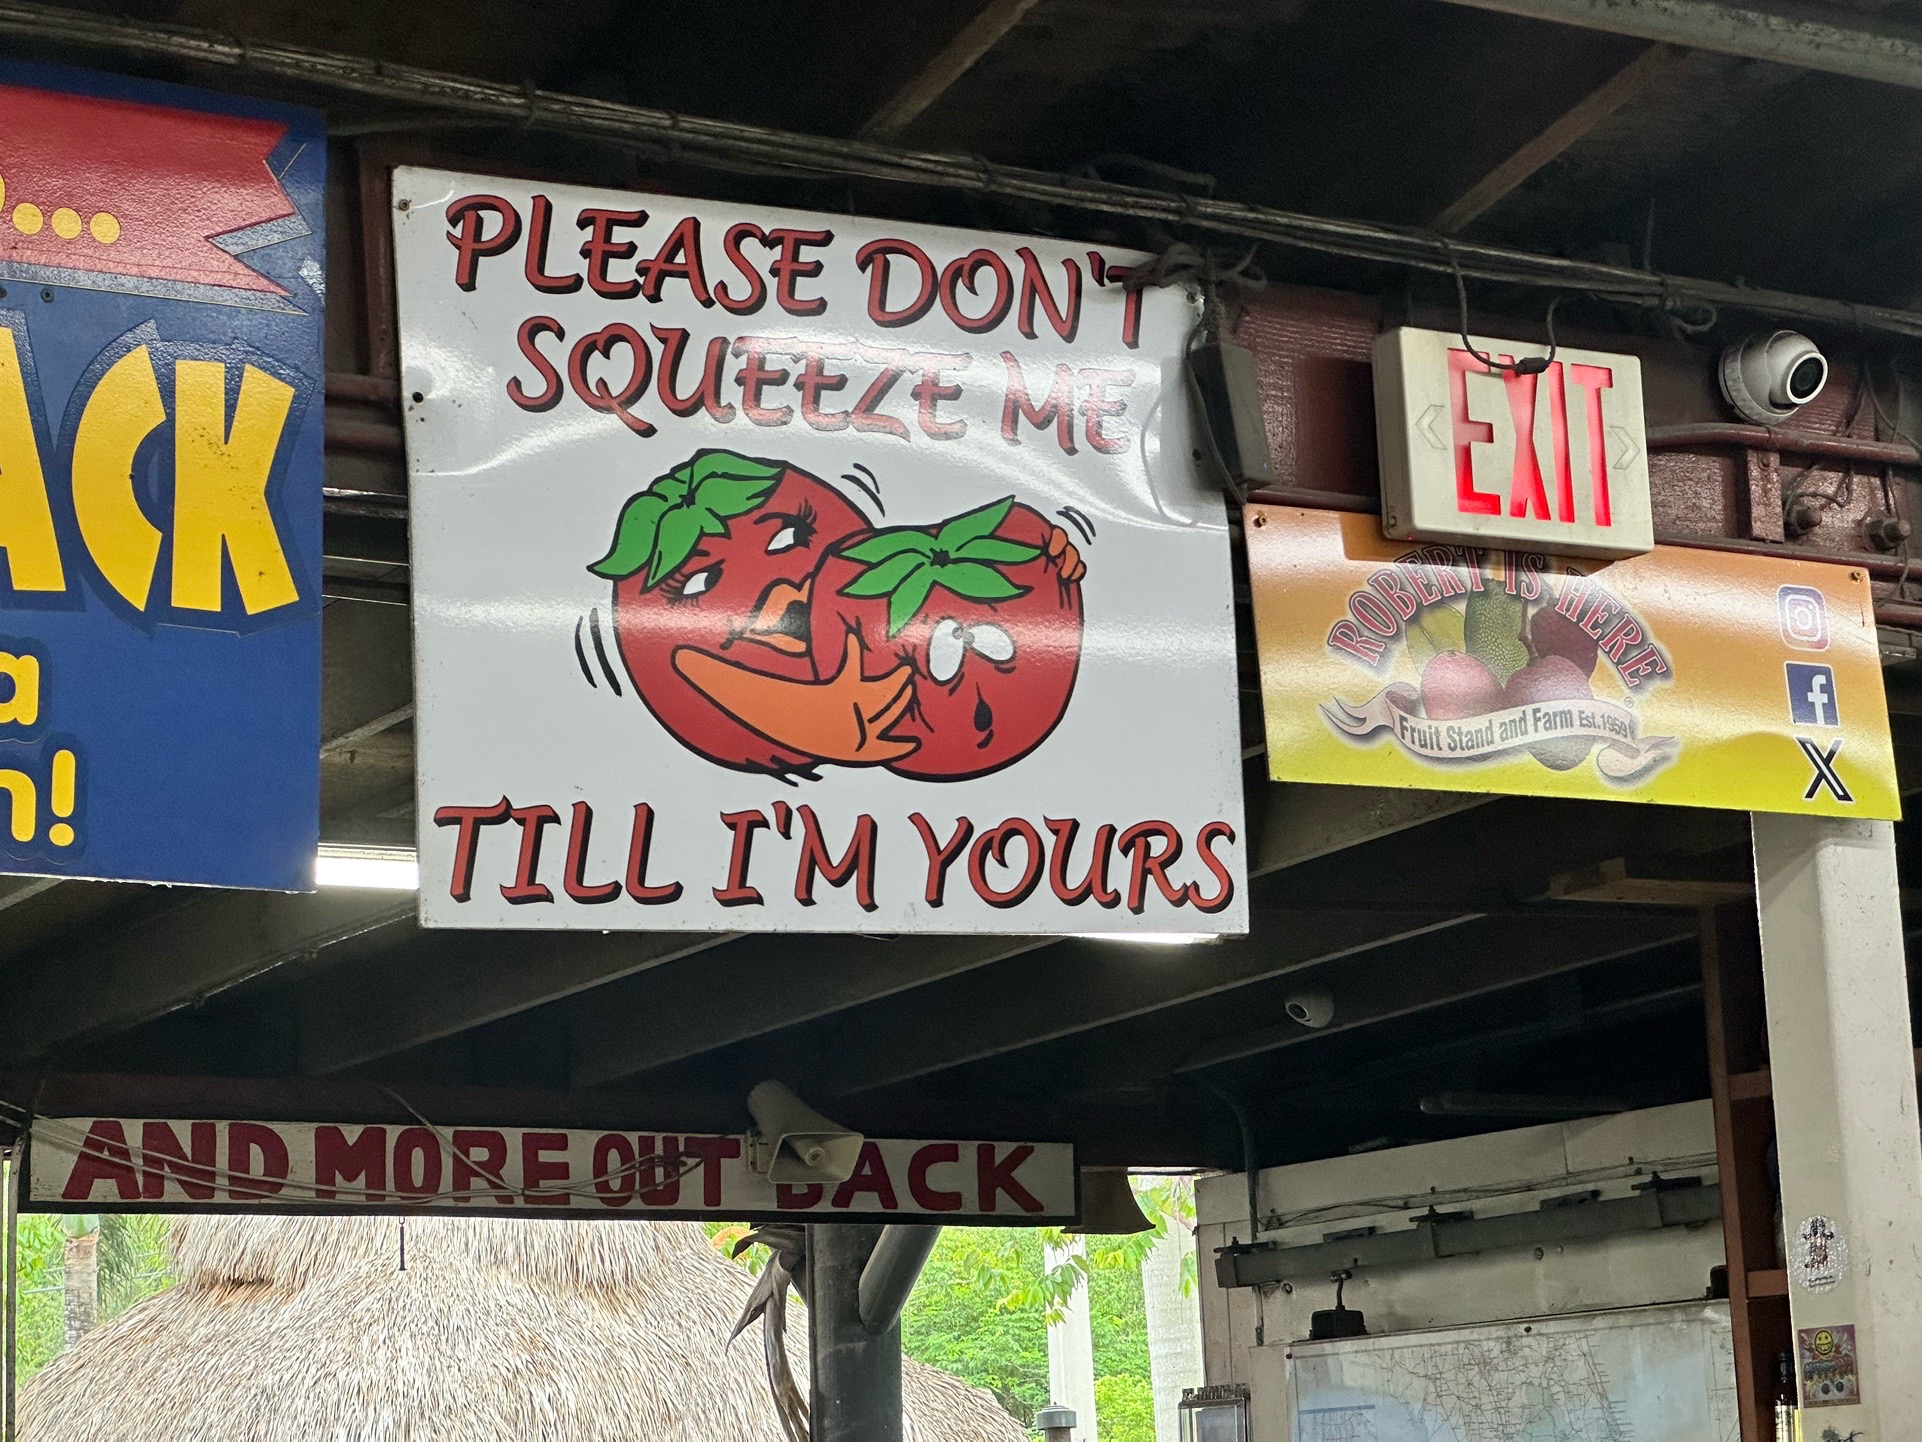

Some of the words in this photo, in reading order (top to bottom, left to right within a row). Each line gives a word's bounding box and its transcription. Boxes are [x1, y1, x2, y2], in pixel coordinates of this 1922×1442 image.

[446, 194, 835, 318] PLEASE
[855, 238, 1152, 349] DON'T
[506, 315, 973, 441] SQUEEZE
[1000, 350, 1139, 456] ME
[1447, 347, 1613, 527] EXIT
[1328, 545, 1484, 667] ROBERT
[1505, 549, 1546, 601] IS
[1555, 567, 1669, 689] HERE
[1399, 714, 1443, 751] Fruit
[1446, 718, 1496, 752] Stand
[1499, 710, 1528, 742] and
[1532, 707, 1574, 733] Farm
[433, 795, 683, 904] TILL
[711, 800, 879, 912] I'M
[907, 811, 1236, 914] YOURS
[61, 1119, 290, 1202] AND
[312, 1125, 573, 1206] MORE
[593, 1133, 741, 1207] OUT
